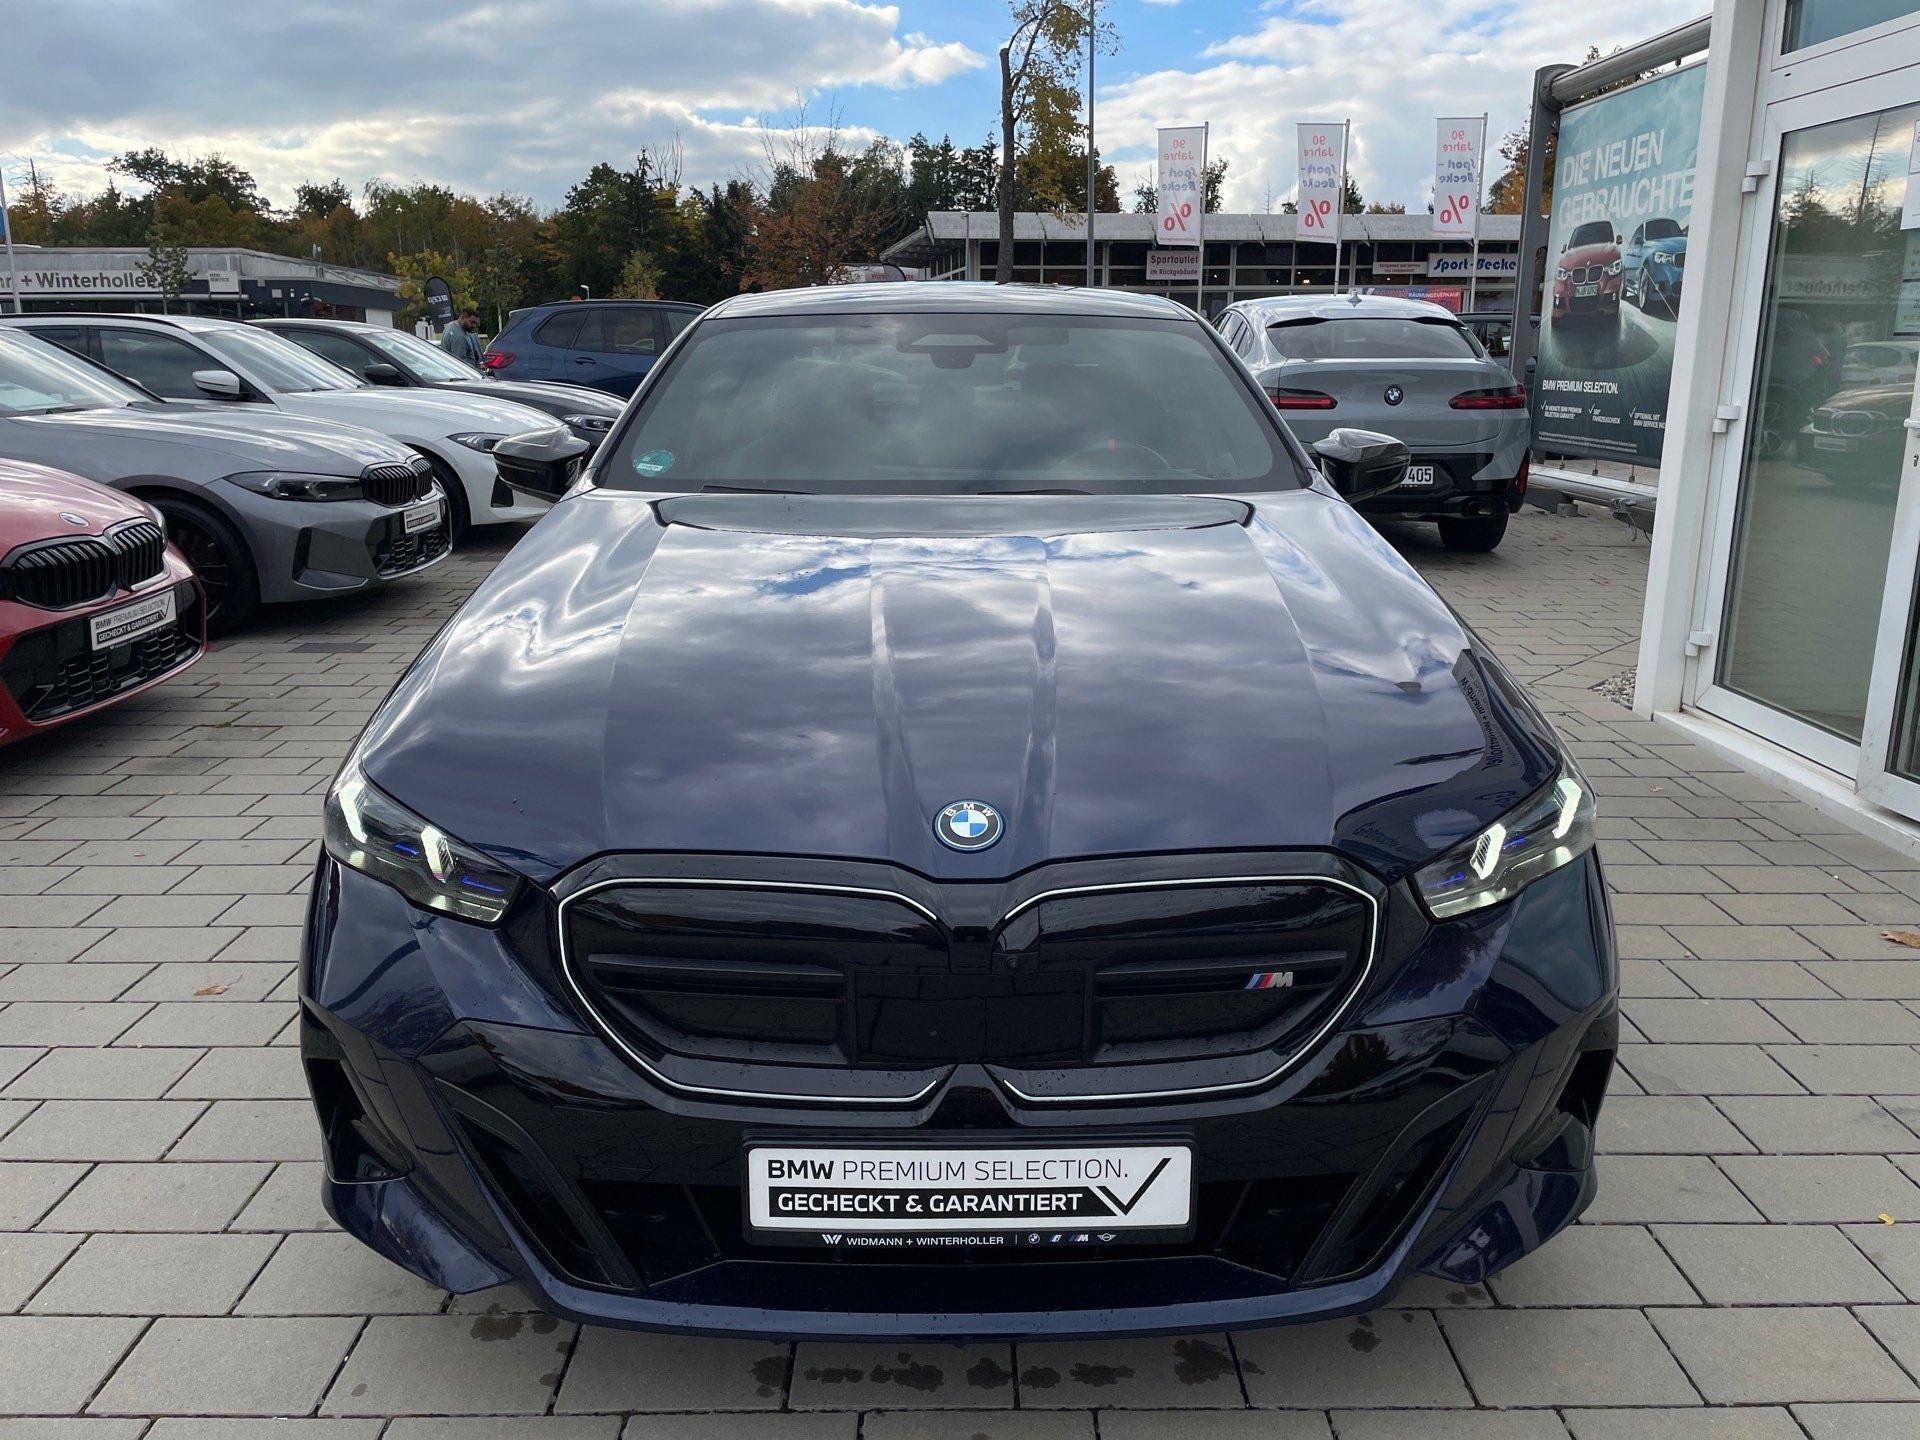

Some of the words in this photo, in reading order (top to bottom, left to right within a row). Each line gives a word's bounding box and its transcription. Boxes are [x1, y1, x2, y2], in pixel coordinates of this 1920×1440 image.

[1561, 150, 1591, 190] DIE
[1594, 128, 1665, 181] NEUEN
[1150, 255, 1199, 265] Sportoutlet
[21, 275, 32, 287] +
[1542, 380, 1556, 390] BMW
[1556, 380, 1582, 392] PREMIUM
[1583, 381, 1619, 394] SELECTION.
[1408, 468, 1431, 482] 405
[95, 617, 112, 630] BMW
[98, 627, 126, 641] GECHECKT
[126, 623, 131, 632] &
[131, 612, 160, 629] GARANTIERT
[944, 801, 994, 817] BMW
[768, 1159, 834, 1179] BMW
[843, 1161, 965, 1181] PREMIUM
[975, 1158, 1128, 1180] SELECTION.
[777, 1193, 901, 1212] GECHECKT
[905, 1195, 924, 1212] &
[929, 1193, 1083, 1212] GARANTIERT
[846, 1237, 903, 1246] WIDMANN
[916, 1236, 1004, 1246] WINTERHOLLER
